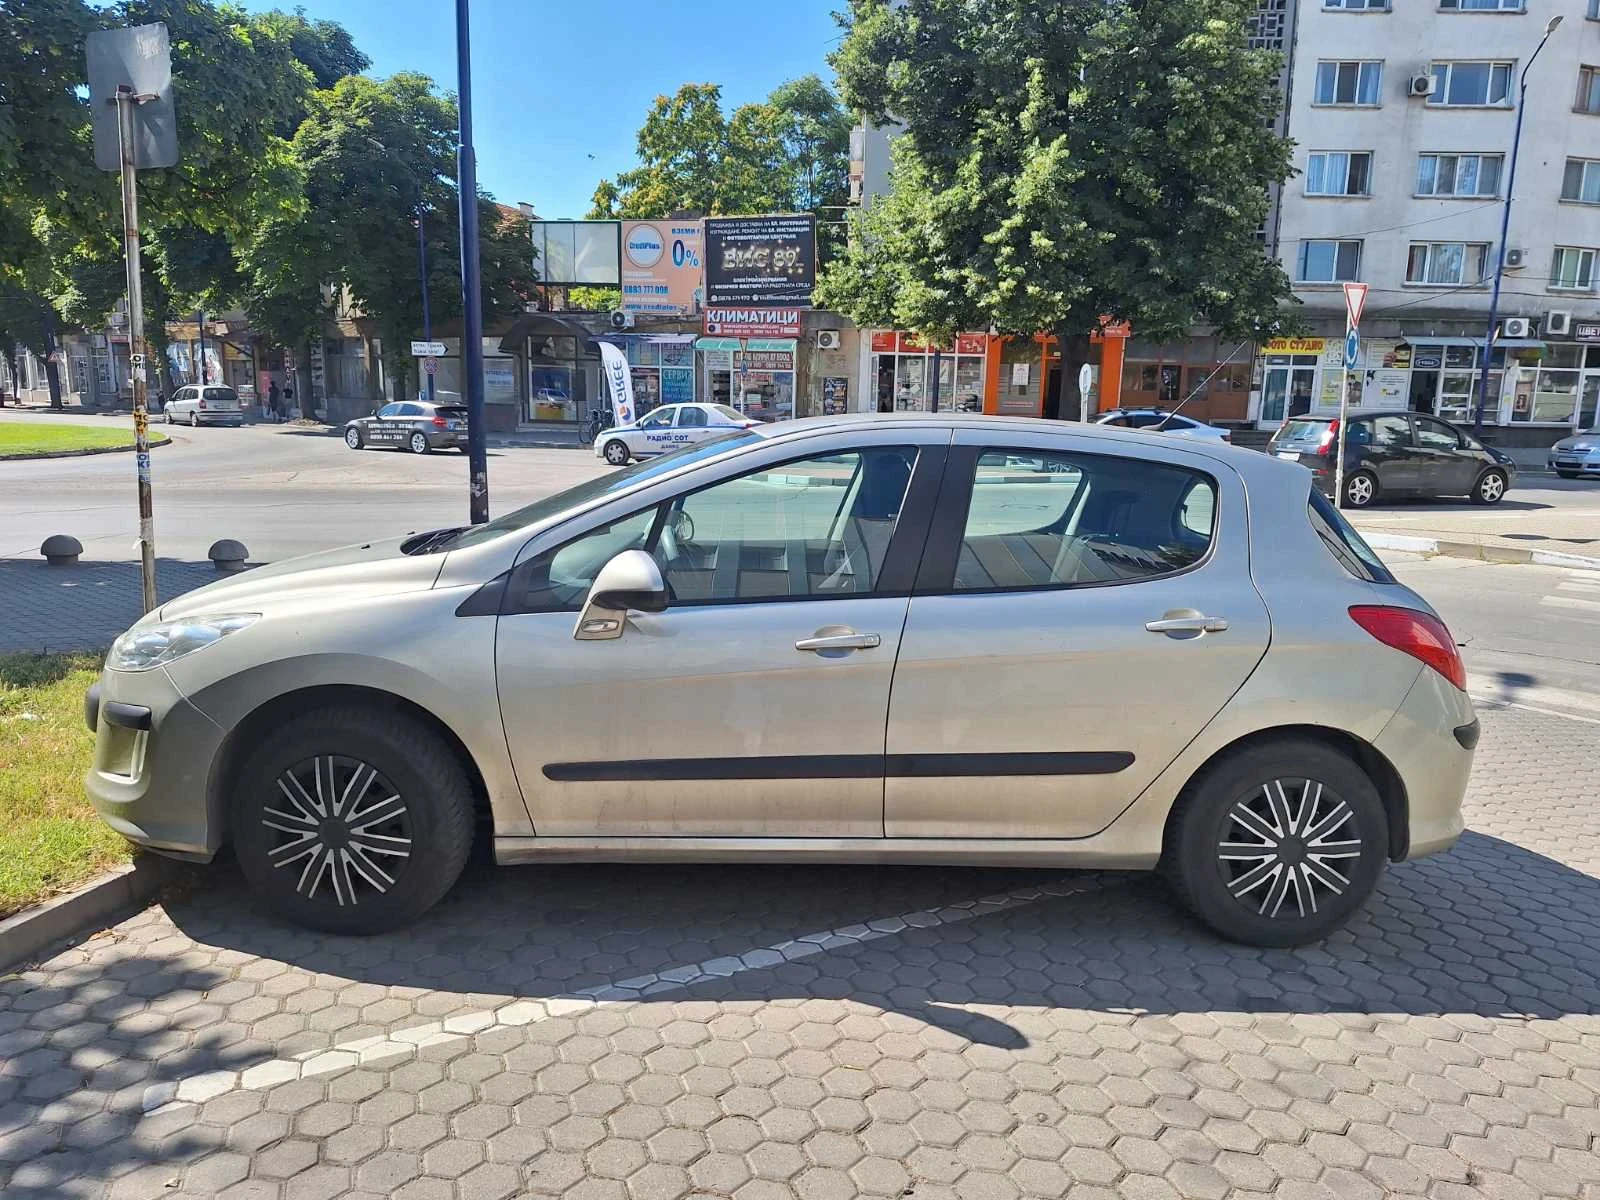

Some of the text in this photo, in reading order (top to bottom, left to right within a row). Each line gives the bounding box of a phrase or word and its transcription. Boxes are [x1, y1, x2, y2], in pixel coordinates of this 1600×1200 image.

[672, 239, 699, 267] 0%
[773, 249, 797, 268] 89
[706, 309, 798, 325] КЛИМАТИЦИ
[1268, 339, 1323, 351] ОТО СТУДИО
[613, 359, 627, 403] GREE
[663, 369, 692, 380] СЕРВИЗ
